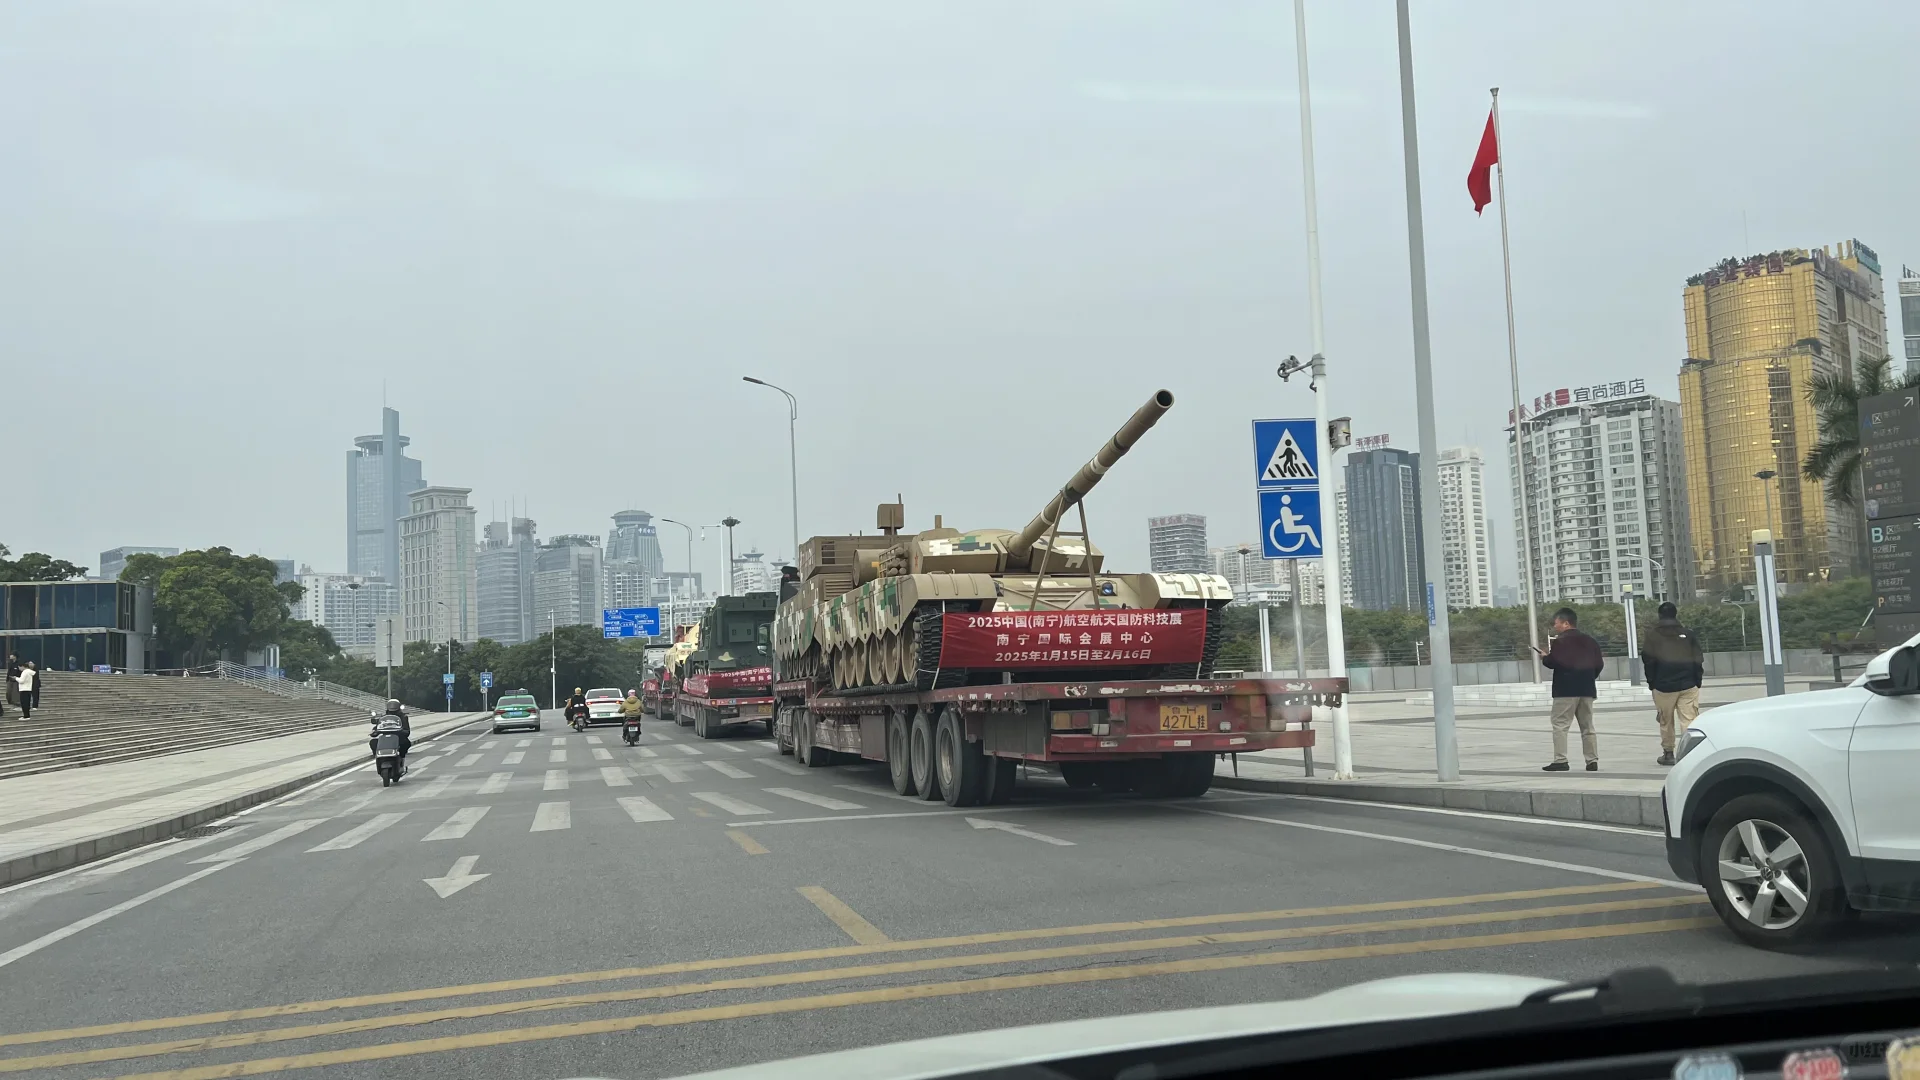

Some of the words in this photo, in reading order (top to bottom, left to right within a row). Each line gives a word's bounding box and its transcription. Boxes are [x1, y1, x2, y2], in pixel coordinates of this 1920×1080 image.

[1573, 378, 1645, 402] 宜尚酒店
[1871, 527, 1884, 543] B
[1878, 596, 1885, 608] P
[968, 612, 1183, 628] 2025中国(南宁)航空航天国防科技展
[996, 631, 1154, 646] 南宁国际会展中心
[995, 649, 1152, 662] 2025年1月15日至2月16日
[1162, 715, 1206, 729] 427L挂
